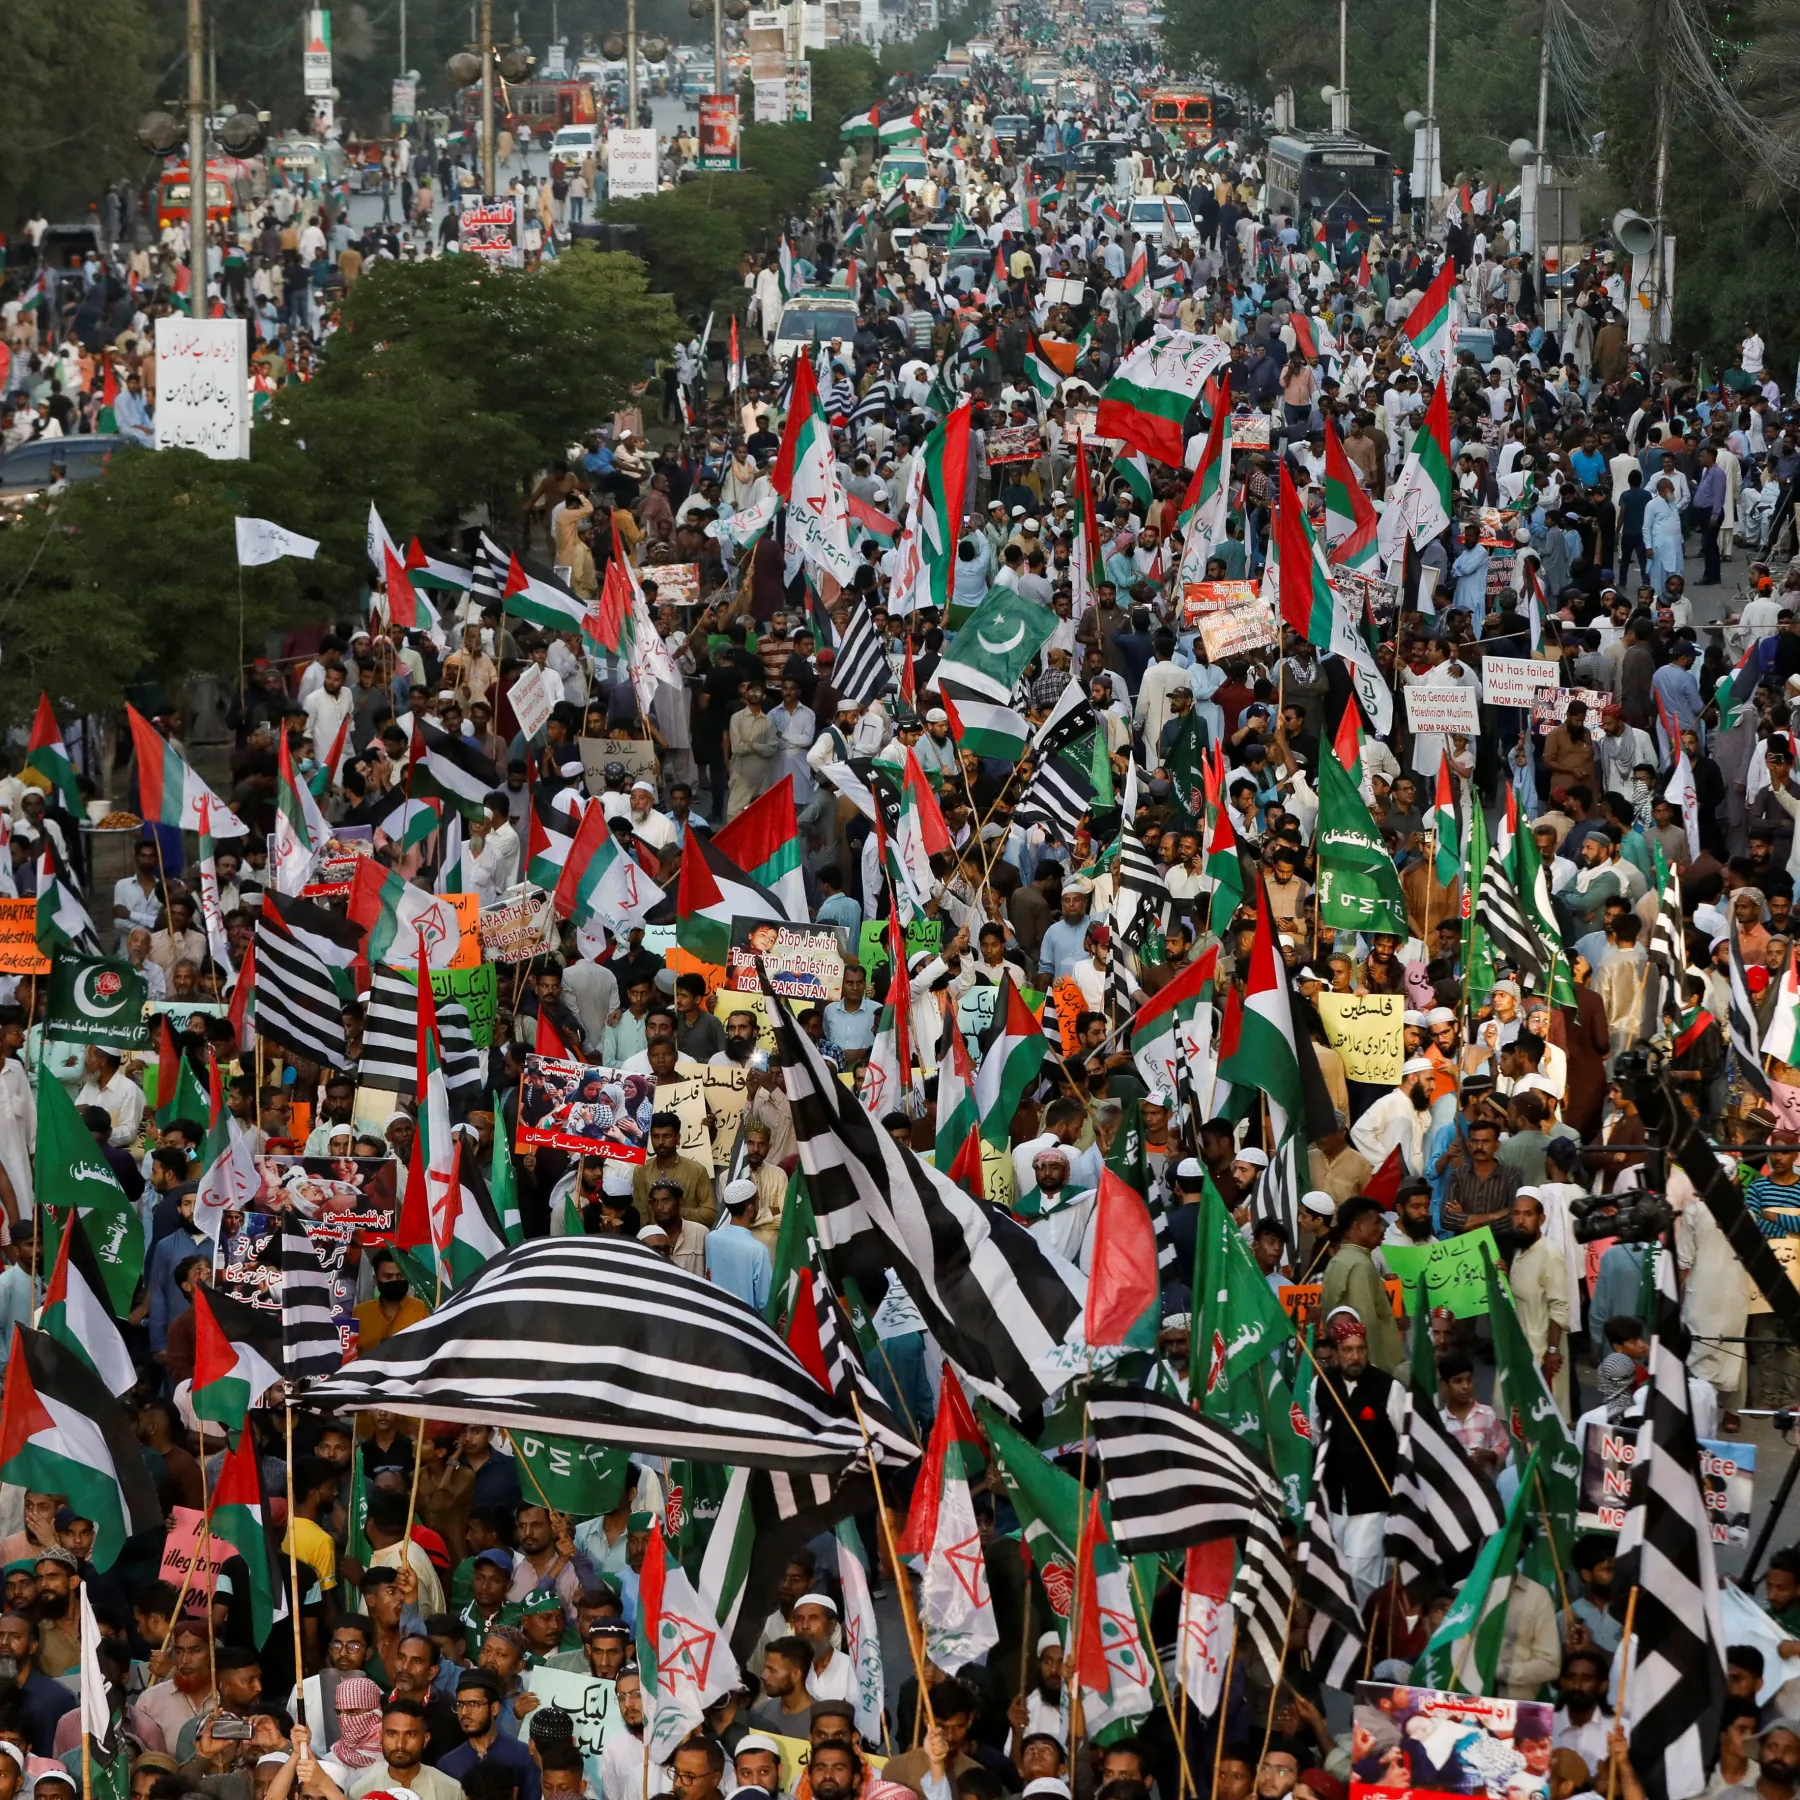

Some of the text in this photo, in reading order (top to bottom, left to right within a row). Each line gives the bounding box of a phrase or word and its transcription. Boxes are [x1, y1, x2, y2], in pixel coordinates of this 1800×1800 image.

[622, 133, 641, 146] Stop
[612, 148, 652, 160] Genocide
[627, 163, 638, 175] of
[704, 159, 731, 168] MQM
[611, 178, 655, 189] Palestinian
[462, 201, 514, 229] فلسطین
[1213, 581, 1252, 597] Stop Jewish
[1187, 598, 1226, 611] Terrorism in
[1215, 628, 1230, 643] UN
[1215, 634, 1271, 658] MQM PAKISTAN
[1487, 662, 1554, 679] UN has failed
[1488, 678, 1523, 692] Muslim
[1412, 690, 1468, 705] Stop Genocide of
[1492, 696, 1534, 708] MQM PAKIS
[1537, 687, 1607, 708] UN has failed
[1410, 706, 1473, 719] Palestinian Muslims
[1536, 705, 1568, 722] Musli
[1417, 723, 1471, 733] MQM PAKISTAN
[480, 900, 541, 932] APARTHEID
[483, 925, 536, 950] Palestine
[778, 927, 838, 951] Stop Jewish
[0, 952, 47, 968] Pakistan
[782, 953, 792, 968] in
[795, 955, 839, 977] Palestine
[771, 980, 828, 998] PAKISTAN
[1339, 996, 1393, 1020] فلسطین
[1363, 1031, 1391, 1056] آزادی
[525, 1132, 561, 1149] پاکستان
[594, 1145, 611, 1157] قومی
[608, 1149, 636, 1160] متحدہ
[234, 1235, 250, 1256] تو
[1451, 1238, 1471, 1257] اے
[1600, 1434, 1636, 1464] No
